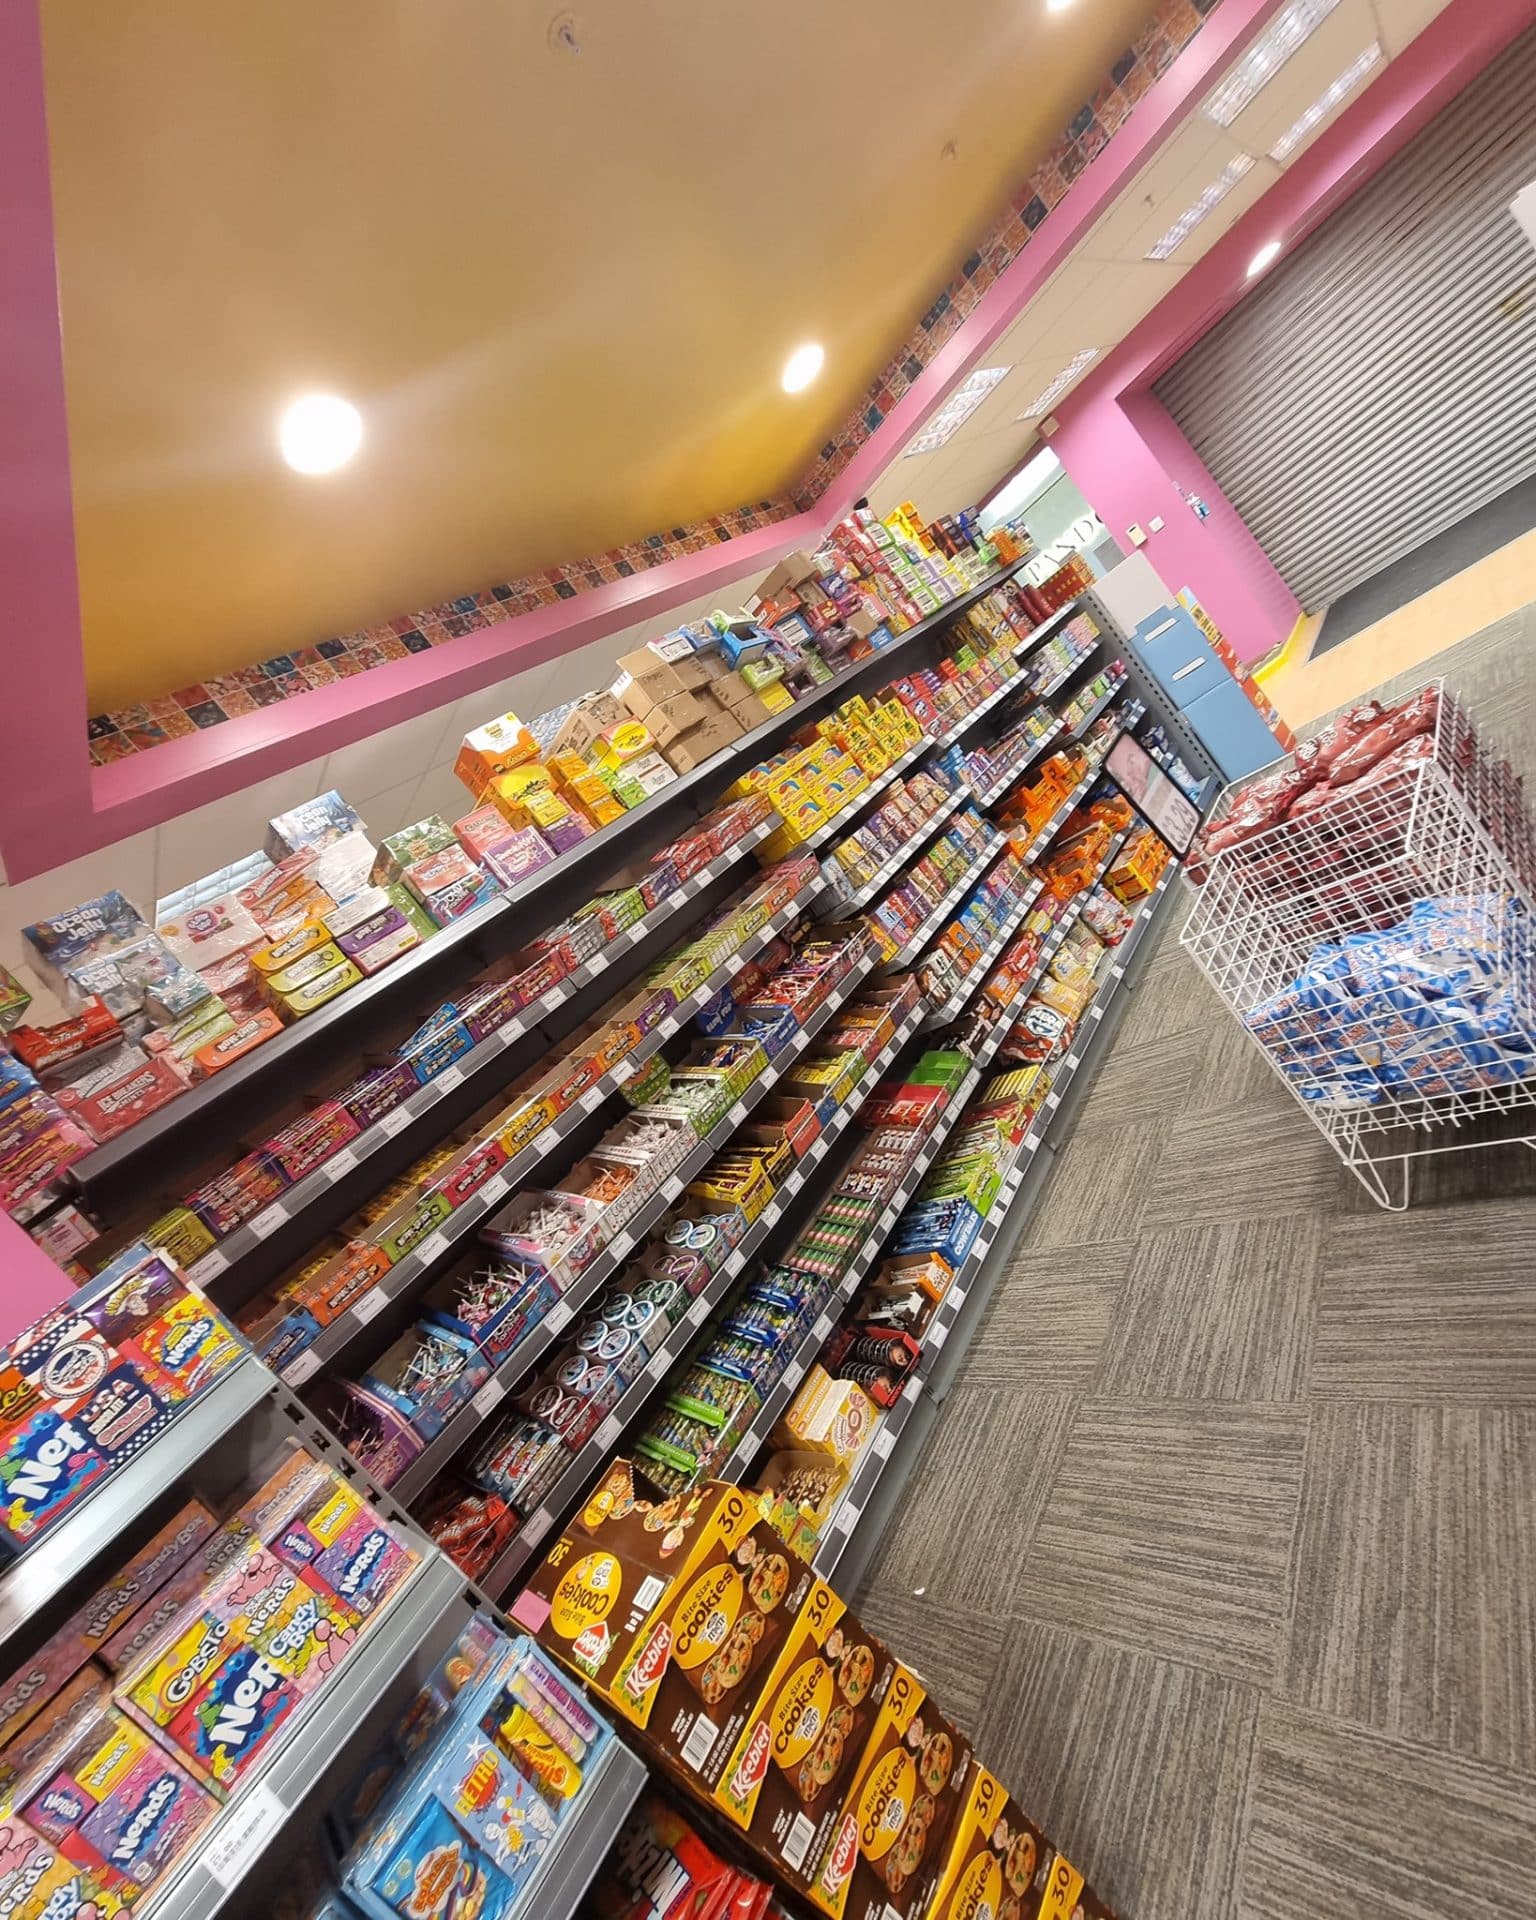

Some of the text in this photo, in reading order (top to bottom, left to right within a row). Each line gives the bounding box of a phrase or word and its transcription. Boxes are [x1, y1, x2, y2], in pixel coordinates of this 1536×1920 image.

[1028, 512, 1104, 580] PAND
[51, 903, 101, 933] Ocean
[66, 917, 105, 944] Jelly
[84, 1378, 135, 1422] USA
[88, 1397, 126, 1435] CHOCOLATE
[717, 1497, 744, 1535] 30
[559, 1581, 610, 1616] Cookies
[676, 1571, 734, 1654] Cookies
[681, 1579, 712, 1624] Bite Size
[808, 1589, 830, 1628] 30
[263, 1597, 324, 1660] Candy
[287, 1611, 323, 1650] Box
[630, 1632, 672, 1696] Keebler
[775, 1664, 826, 1755] Cookies
[778, 1674, 805, 1723] Bite Size
[889, 1678, 910, 1717] 30
[454, 1749, 501, 1817] RETRO
[731, 1733, 770, 1800] Keebler
[862, 1756, 907, 1848] Cookies
[865, 1767, 890, 1815] Bite Size
[974, 1778, 995, 1820] 30
[824, 1823, 858, 1892] Keebler
[955, 1870, 979, 1917] Bite Size
[1052, 1865, 1072, 1908] 30
